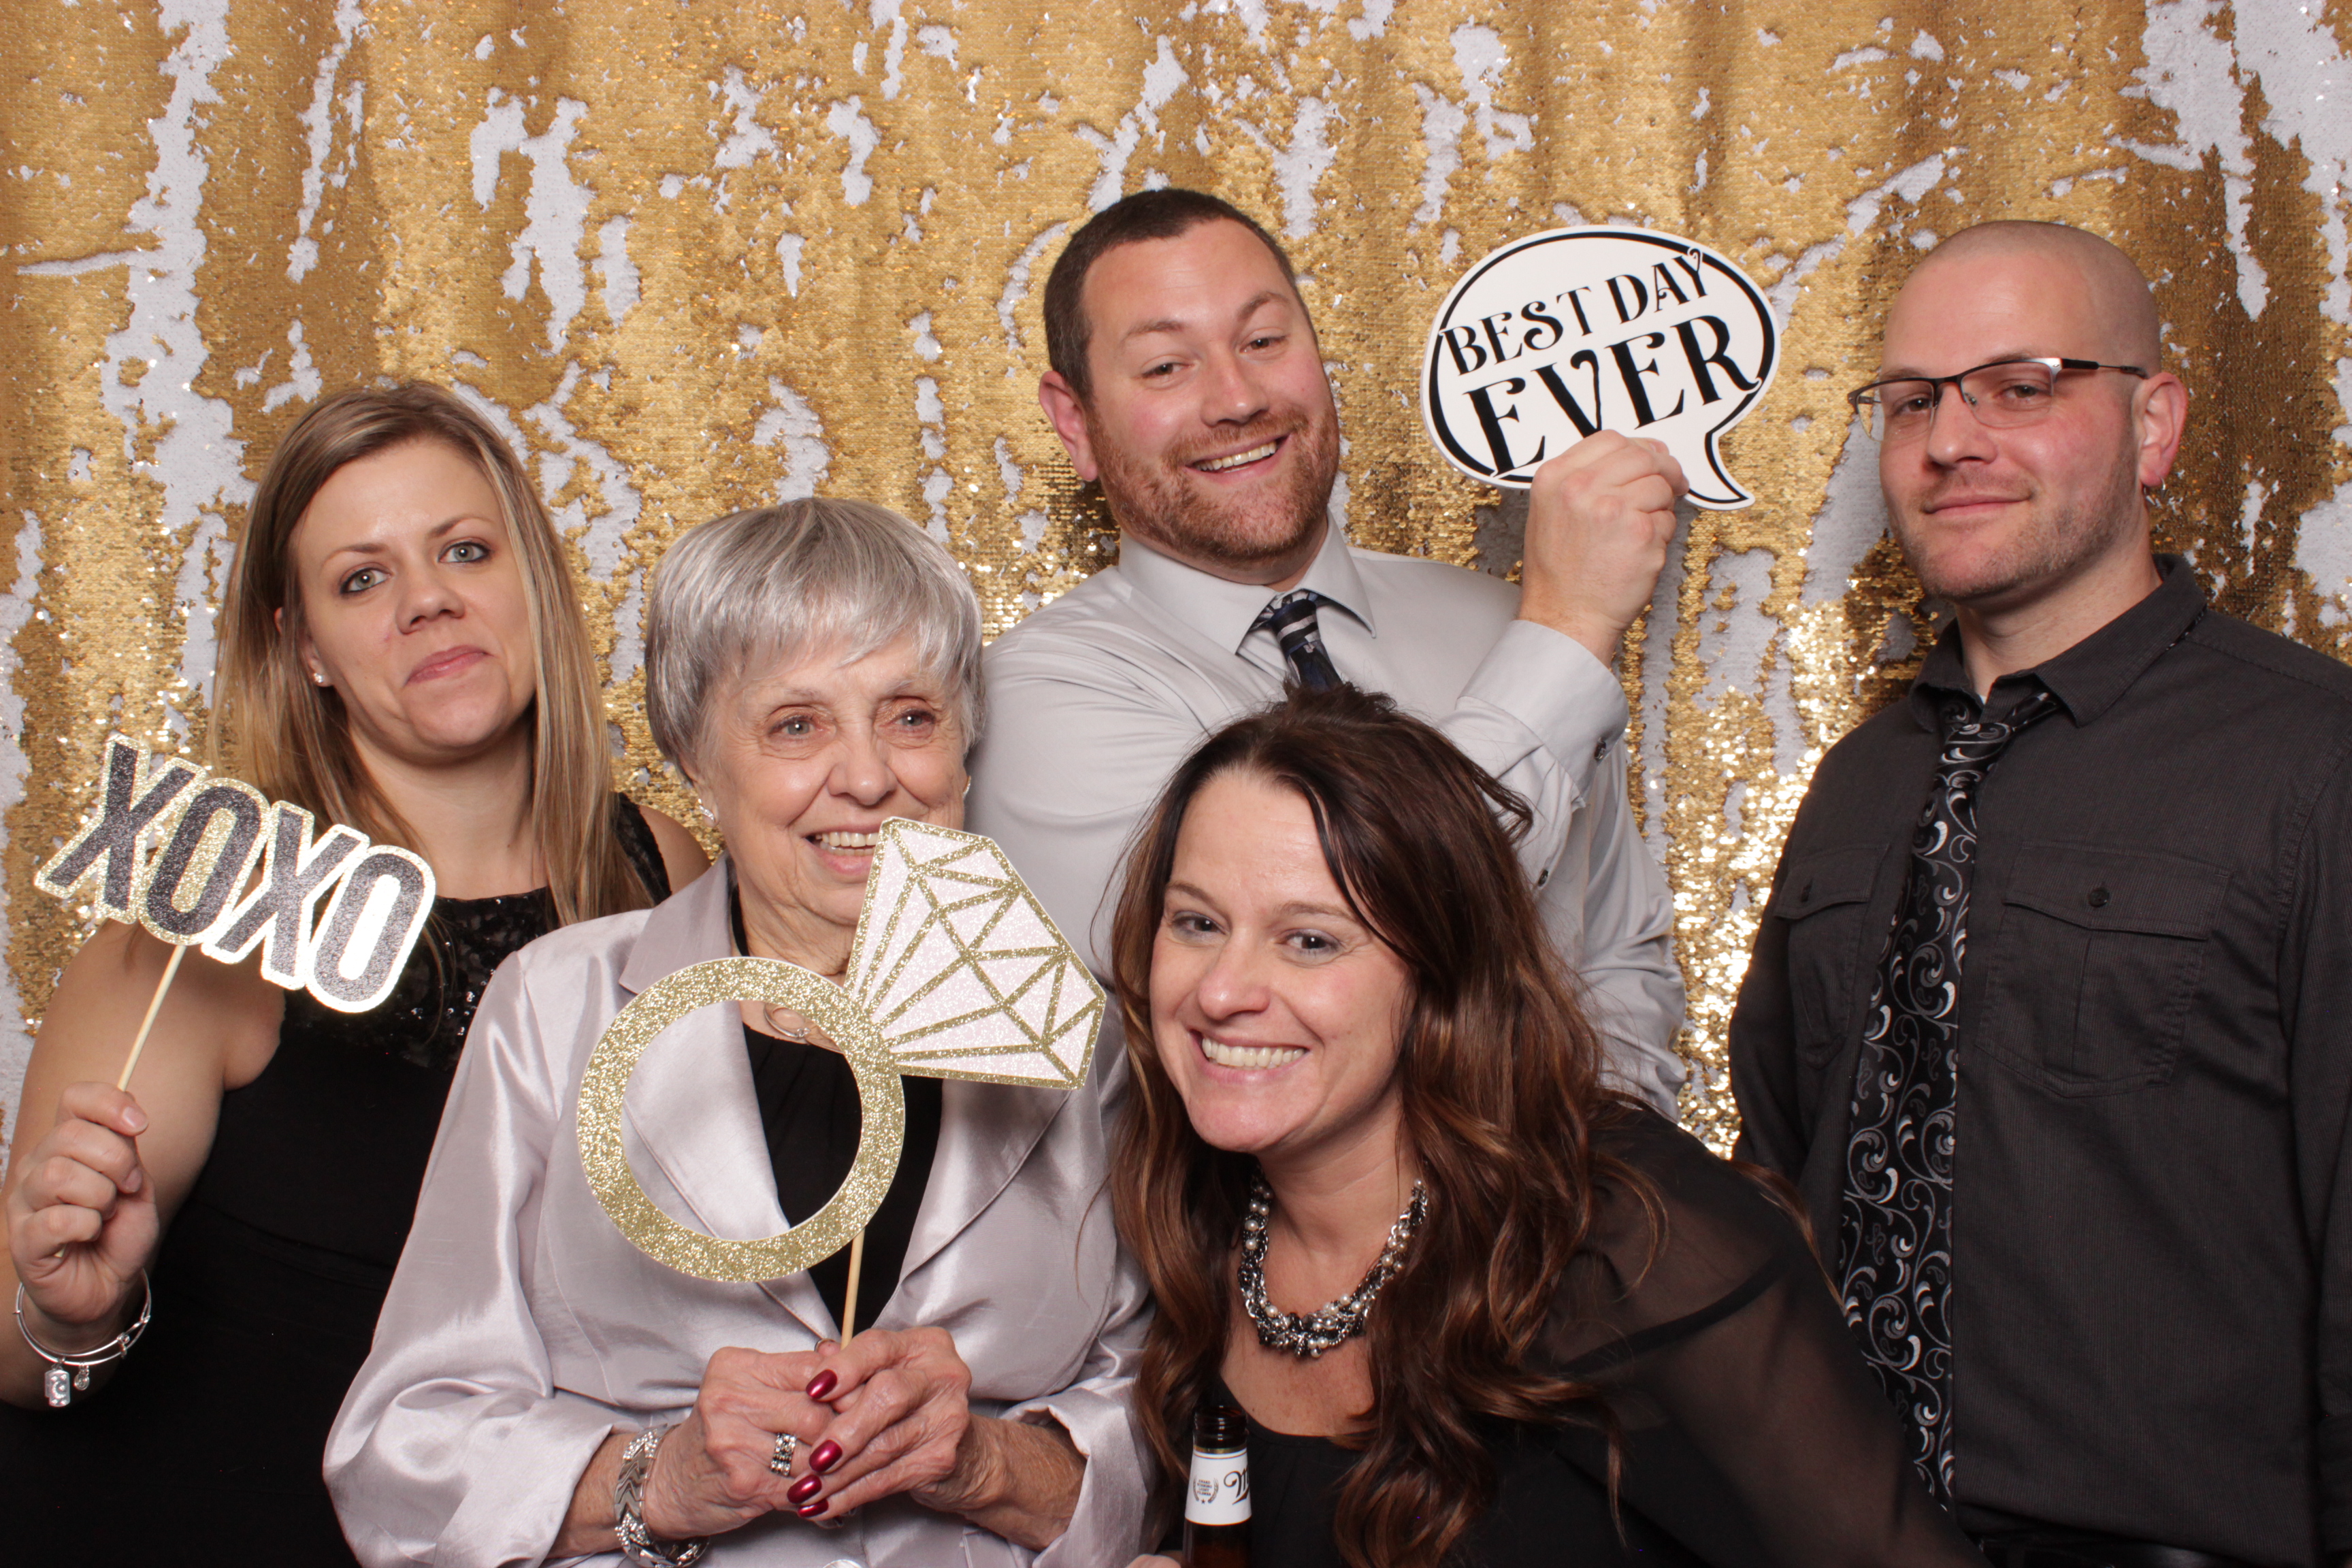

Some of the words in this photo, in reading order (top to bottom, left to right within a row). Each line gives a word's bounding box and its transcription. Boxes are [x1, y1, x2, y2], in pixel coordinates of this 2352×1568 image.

[1439, 285, 1593, 376] BEST
[1604, 247, 1708, 325] DAY
[1461, 315, 1762, 474] EVER
[46, 742, 426, 1003] XOXO
